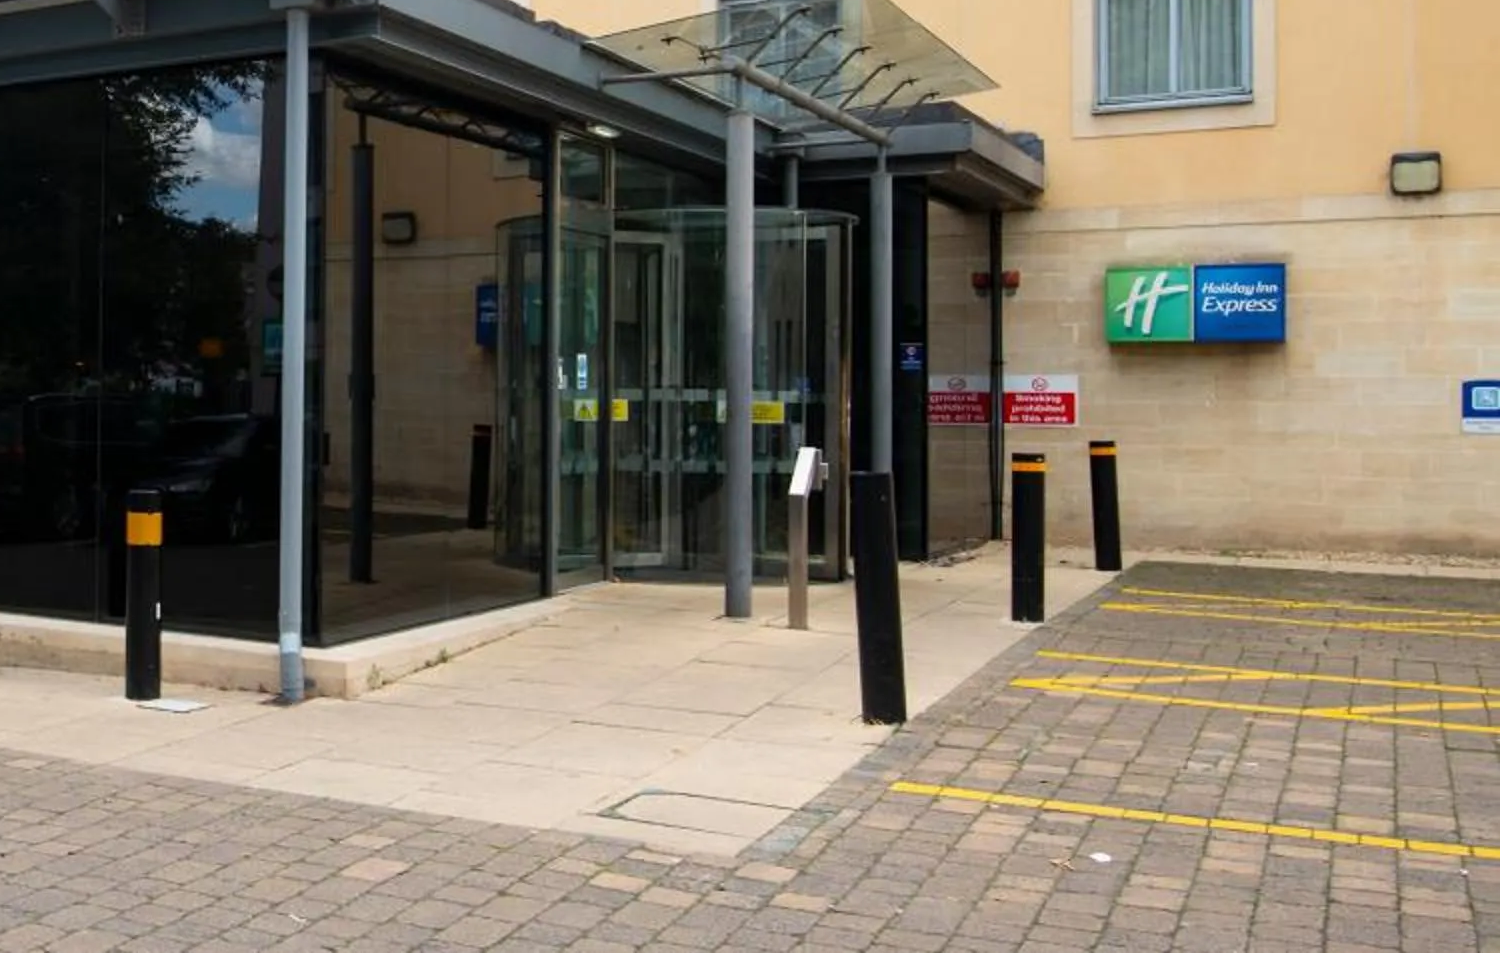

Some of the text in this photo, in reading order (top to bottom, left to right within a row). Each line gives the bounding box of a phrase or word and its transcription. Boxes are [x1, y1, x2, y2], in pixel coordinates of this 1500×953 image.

[1202, 281, 1278, 295] Holiday Inn
[1202, 297, 1278, 316] Express
[1015, 394, 1062, 403] Smoking
[1011, 404, 1066, 413] prohibited
[1021, 414, 1042, 422] this
